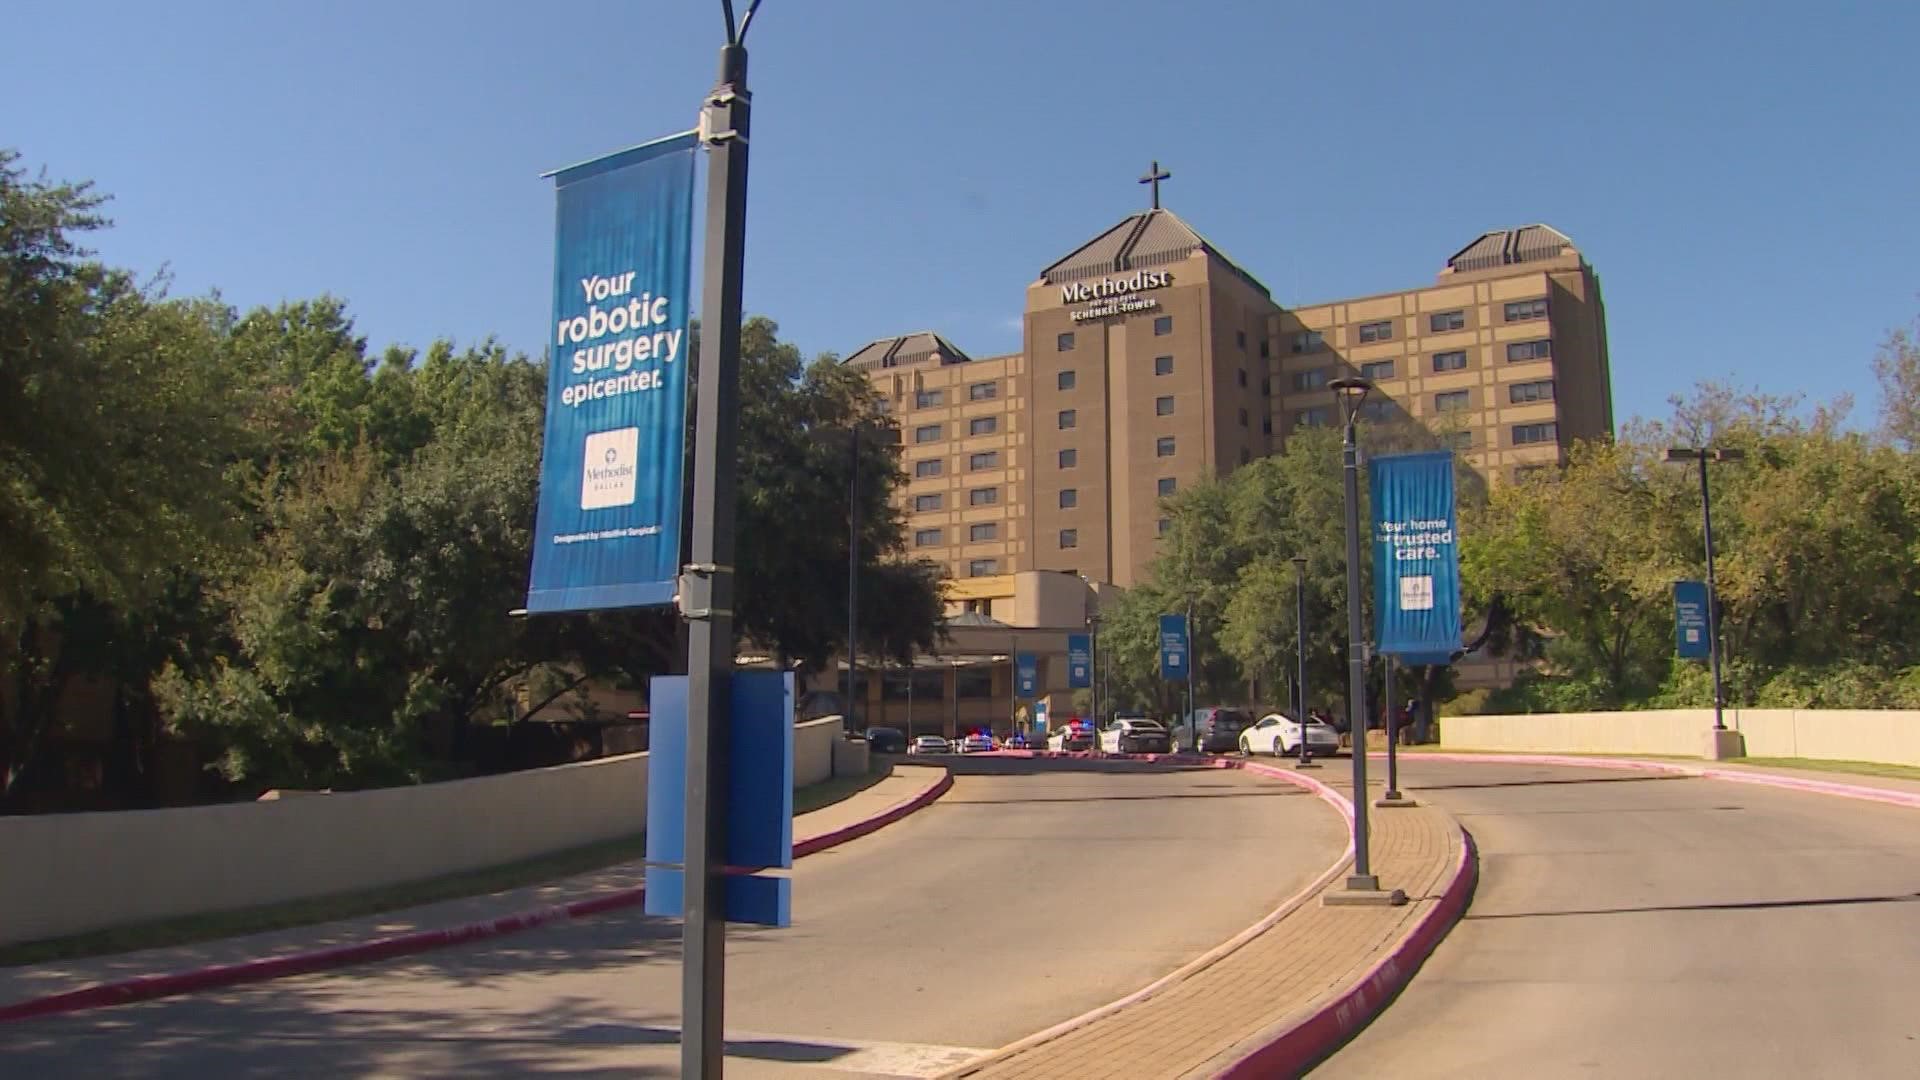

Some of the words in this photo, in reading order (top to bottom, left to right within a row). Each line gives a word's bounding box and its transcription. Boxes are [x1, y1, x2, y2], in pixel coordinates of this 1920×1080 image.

[582, 271, 636, 303] Your
[1061, 269, 1169, 304] Methodist
[558, 291, 669, 346] robotic
[1120, 299, 1157, 313] TOWER
[572, 328, 682, 375] surgery
[562, 368, 663, 408] epicenter.
[586, 463, 633, 482] Methodist
[1379, 521, 1407, 533] Your
[1410, 519, 1447, 530] home
[1396, 546, 1441, 560] care.
